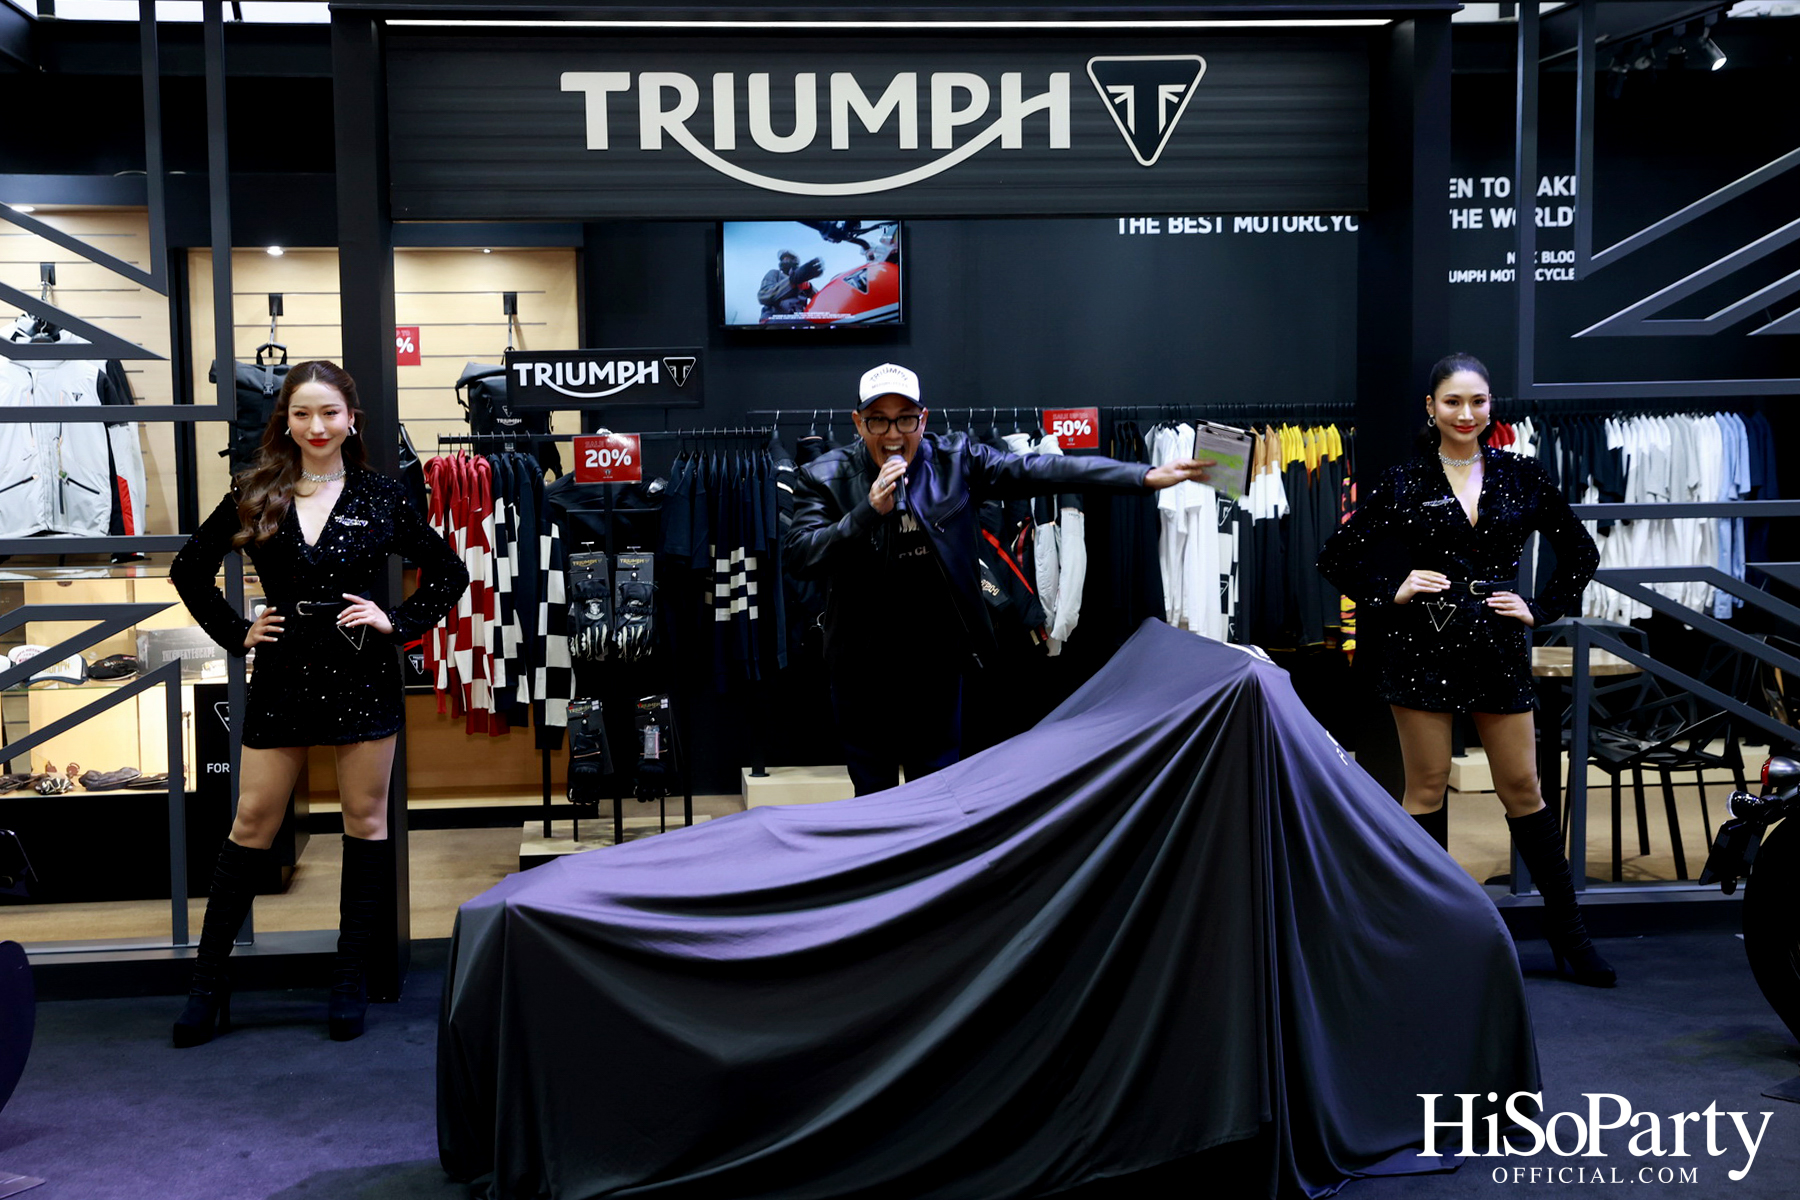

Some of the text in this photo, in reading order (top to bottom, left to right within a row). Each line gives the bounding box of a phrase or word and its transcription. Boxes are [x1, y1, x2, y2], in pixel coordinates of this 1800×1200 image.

[560, 72, 1071, 196] TRIUMPH
[1480, 177, 1511, 198] TO
[1116, 216, 1160, 235] THE
[1168, 216, 1222, 234] BEST
[1449, 208, 1483, 229] HE
[512, 361, 659, 398] TRIUMPH
[870, 367, 909, 382] TRIUMPH
[496, 417, 522, 426] TRIUMPH
[1053, 419, 1092, 437] 50%
[585, 448, 632, 468] 20%
[206, 762, 230, 773] FOR
